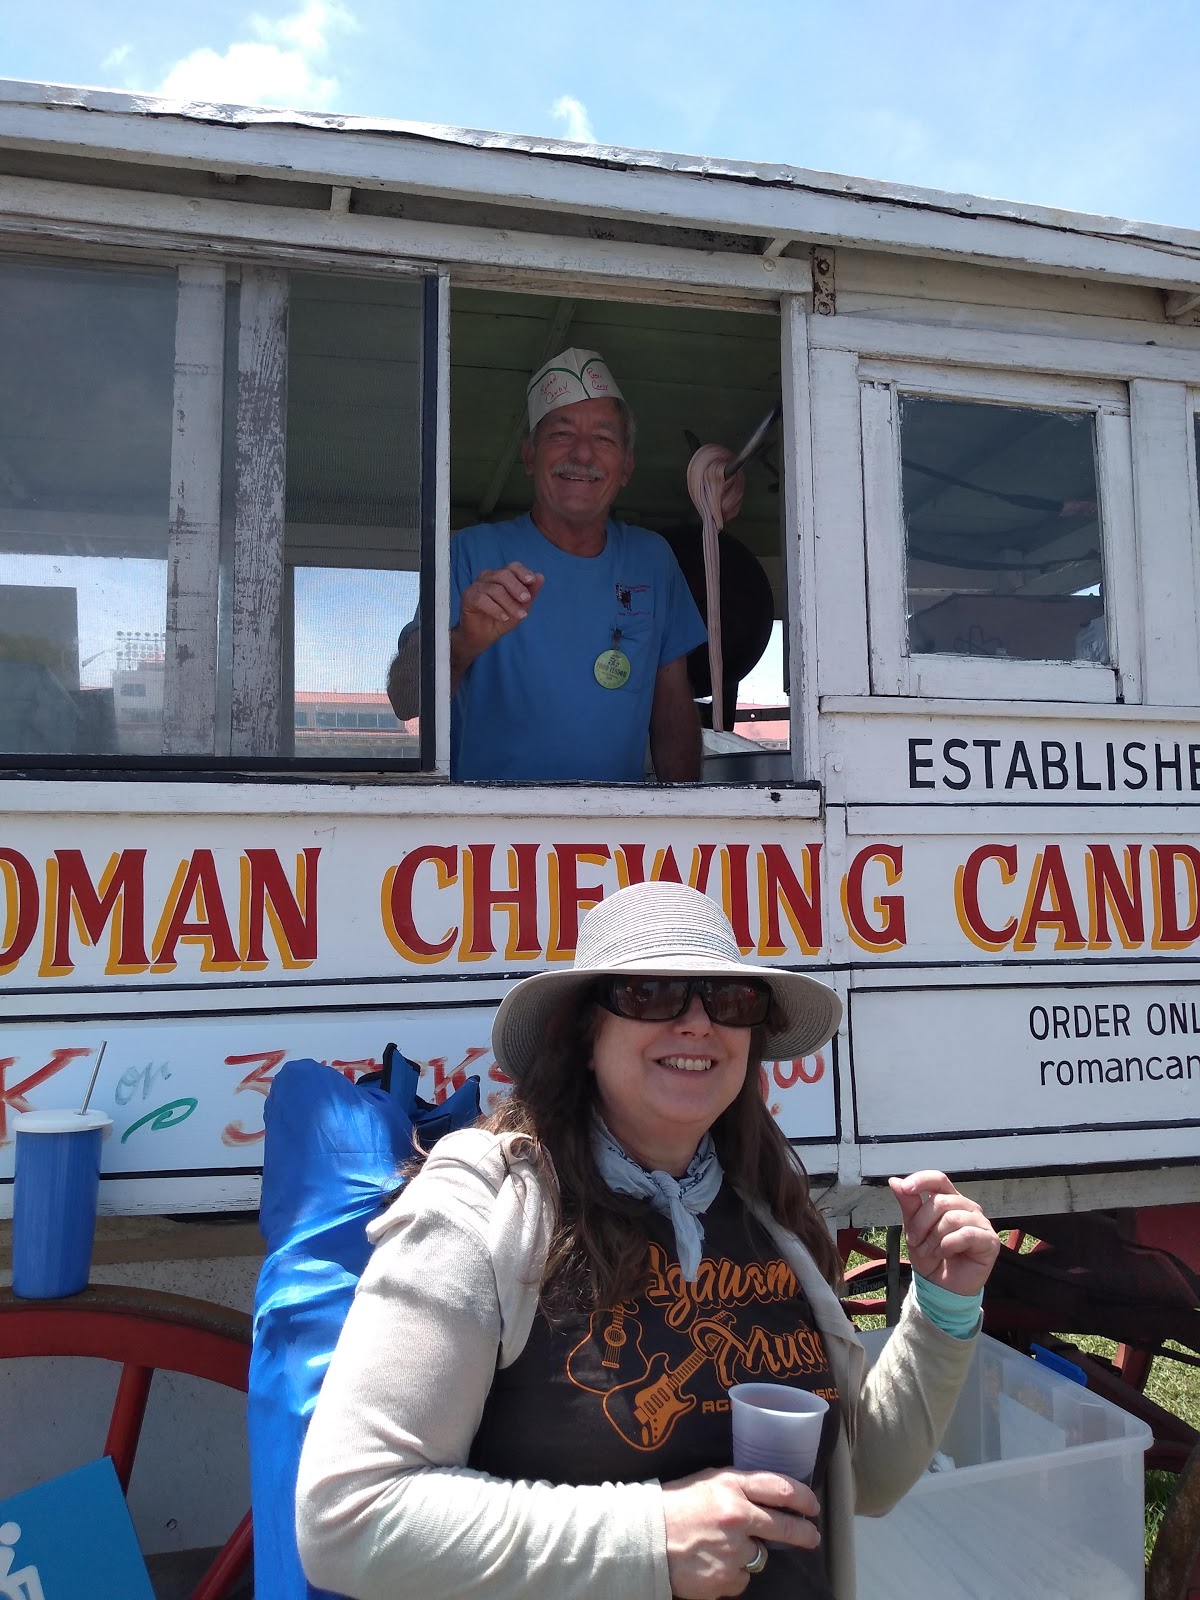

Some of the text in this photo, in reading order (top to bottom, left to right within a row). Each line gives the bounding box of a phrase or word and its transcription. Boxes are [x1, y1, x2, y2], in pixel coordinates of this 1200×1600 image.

[954, 843, 1200, 952] CAND
[1029, 1002, 1200, 1040] ORDER ONL
[1040, 1055, 1200, 1086] romancan
